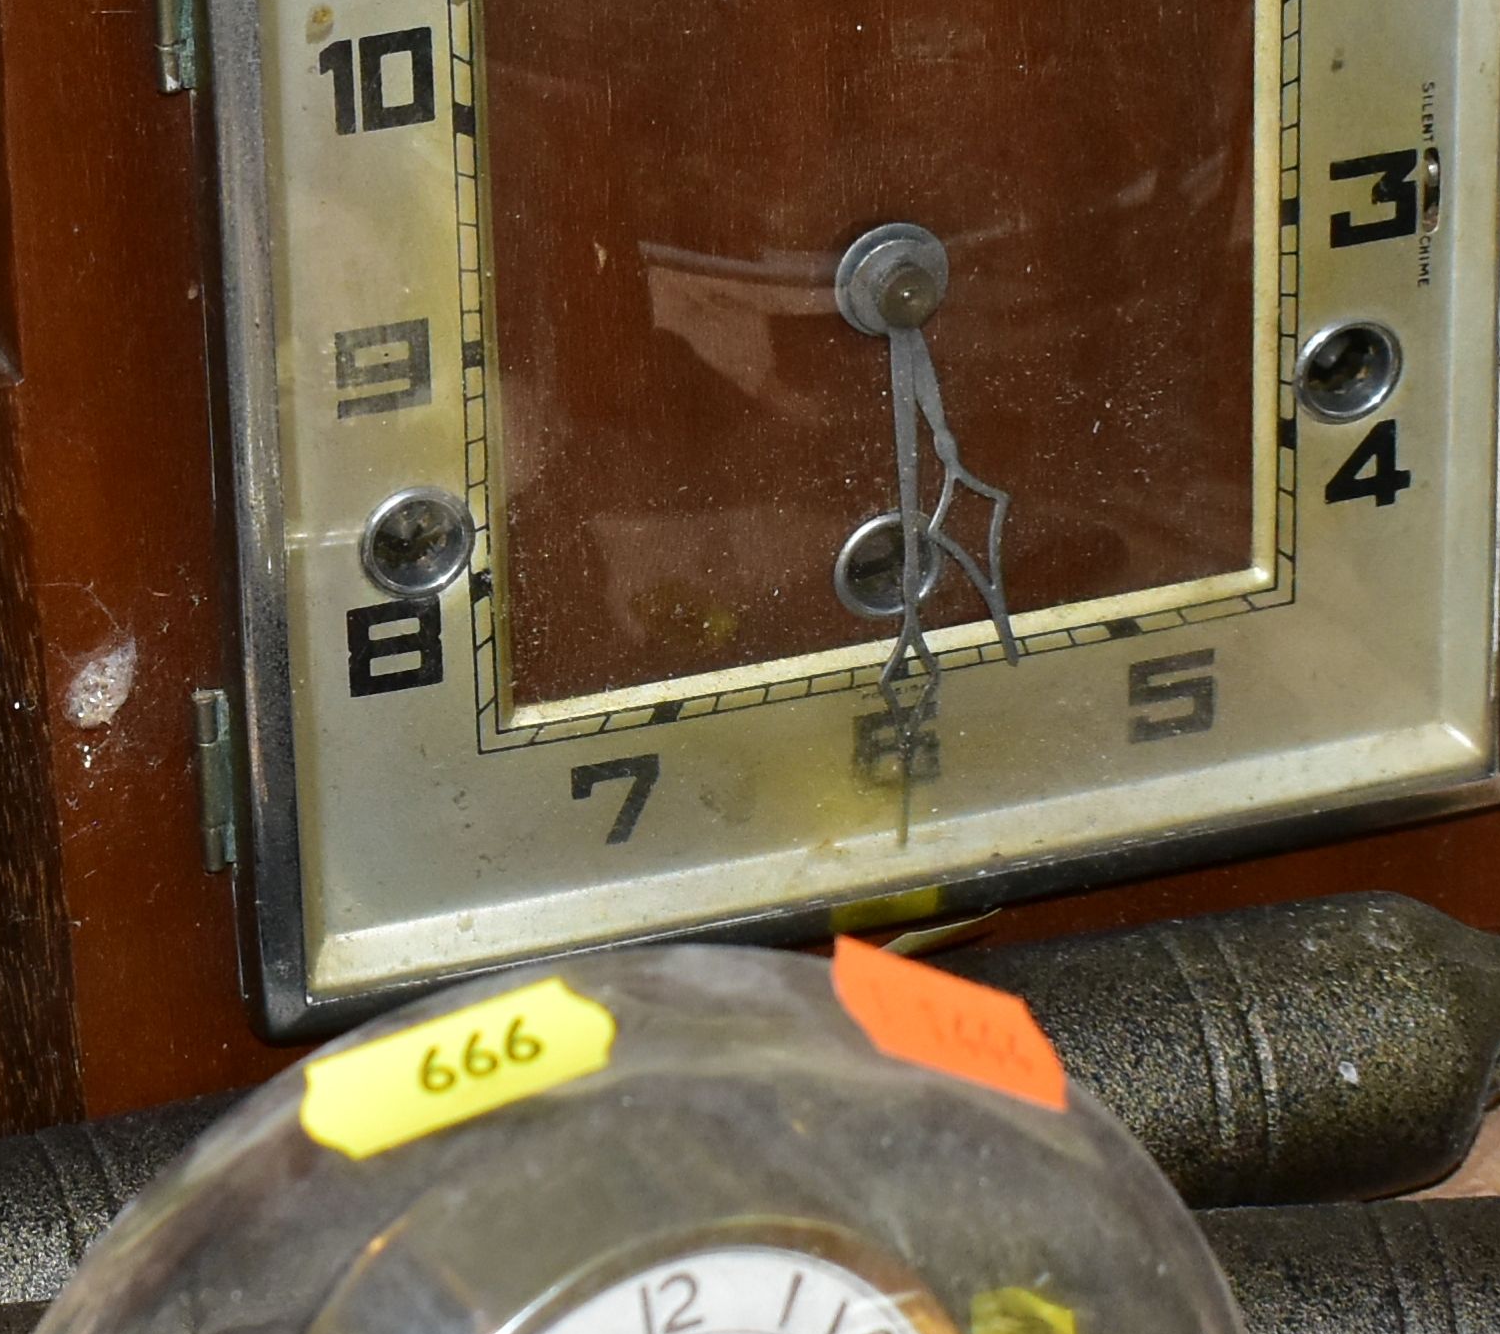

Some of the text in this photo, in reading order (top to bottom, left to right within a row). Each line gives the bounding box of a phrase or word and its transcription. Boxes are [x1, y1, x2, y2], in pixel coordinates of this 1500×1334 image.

[318, 25, 435, 135] 10
[1421, 81, 1436, 143] SILENT
[1329, 148, 1419, 252] 3
[1417, 234, 1432, 288] CHIME
[333, 317, 431, 420] 9
[1324, 419, 1414, 508] 4
[346, 596, 444, 698] 8
[1127, 648, 1216, 743] 5
[569, 754, 658, 846] 7
[417, 1017, 544, 1095] 666
